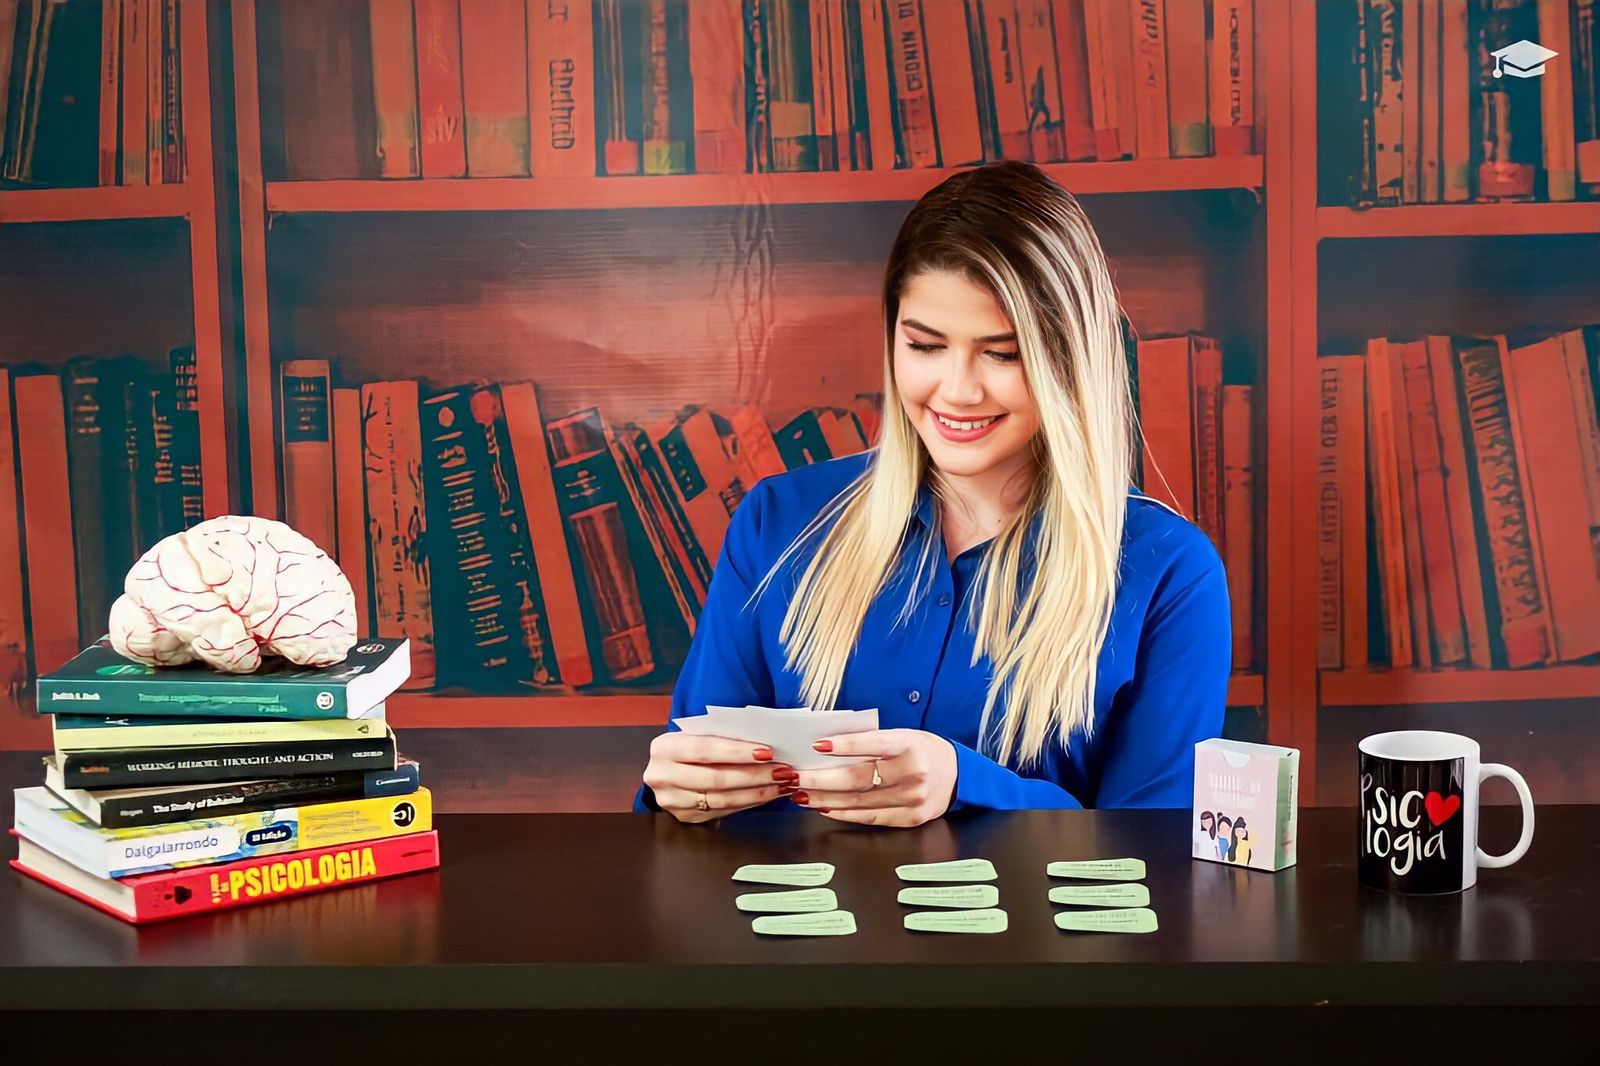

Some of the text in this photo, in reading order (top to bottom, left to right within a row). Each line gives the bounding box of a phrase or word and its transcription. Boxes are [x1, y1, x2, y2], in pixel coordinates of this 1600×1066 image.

[124, 835, 219, 859] Dalgalarrondo
[1366, 809, 1447, 876] logia
[228, 846, 377, 901] PSICOLOGIA
